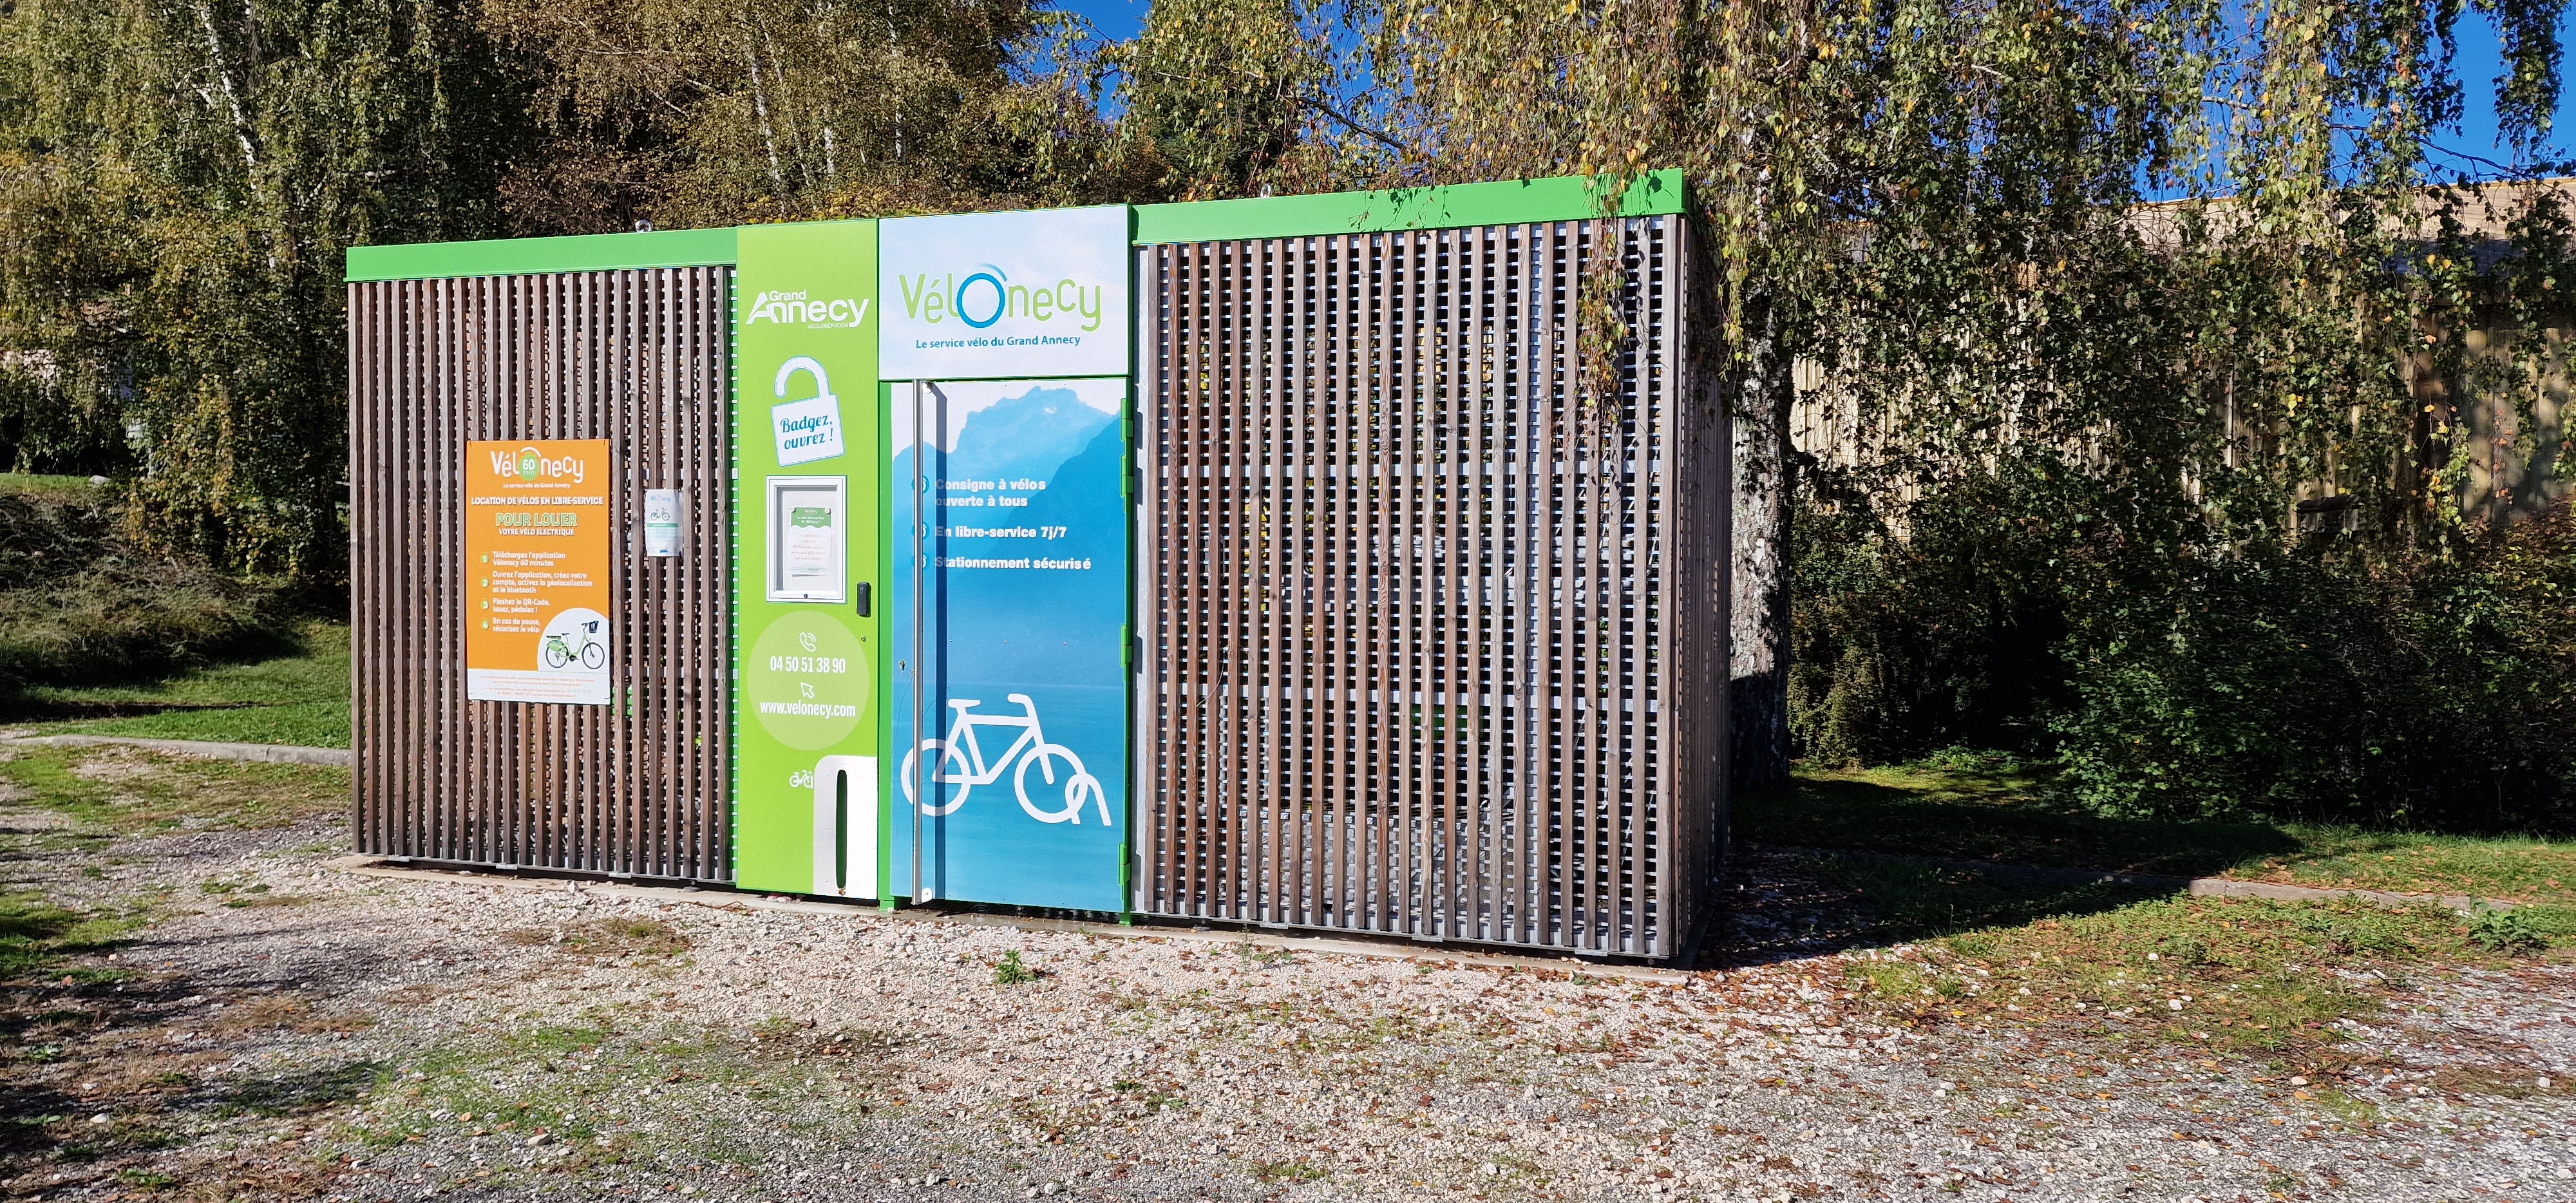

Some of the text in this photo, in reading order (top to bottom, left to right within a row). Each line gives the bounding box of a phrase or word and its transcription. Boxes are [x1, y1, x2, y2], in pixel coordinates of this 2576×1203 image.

[769, 290, 806, 301] Grand
[746, 291, 869, 328] Annecy
[916, 336, 1081, 348] Le service vélo du Grand Annecy
[780, 415, 833, 433] Badgez,
[784, 433, 825, 450] ouvrez
[522, 459, 535, 470] 60
[935, 478, 1046, 492] Consigne à vélos
[471, 497, 506, 505] LOCATION
[518, 495, 540, 505] VÉLOS
[541, 497, 550, 505] EN
[551, 497, 603, 505] LIBRE-SERVICE
[935, 495, 1028, 507] ouverte à tous
[496, 513, 578, 527] POUR LOUER
[520, 527, 536, 535] VÉLO
[536, 527, 574, 536] ÉLECTRIQUE
[935, 526, 1067, 540] En libre-service 7j/7
[493, 559, 519, 567] Vélonecy
[935, 556, 1092, 570] Stationnement sécurisé
[511, 605, 535, 614] pédalez
[770, 656, 846, 674] 04 50 51 38 90
[760, 699, 856, 720] www.velonecy.com
